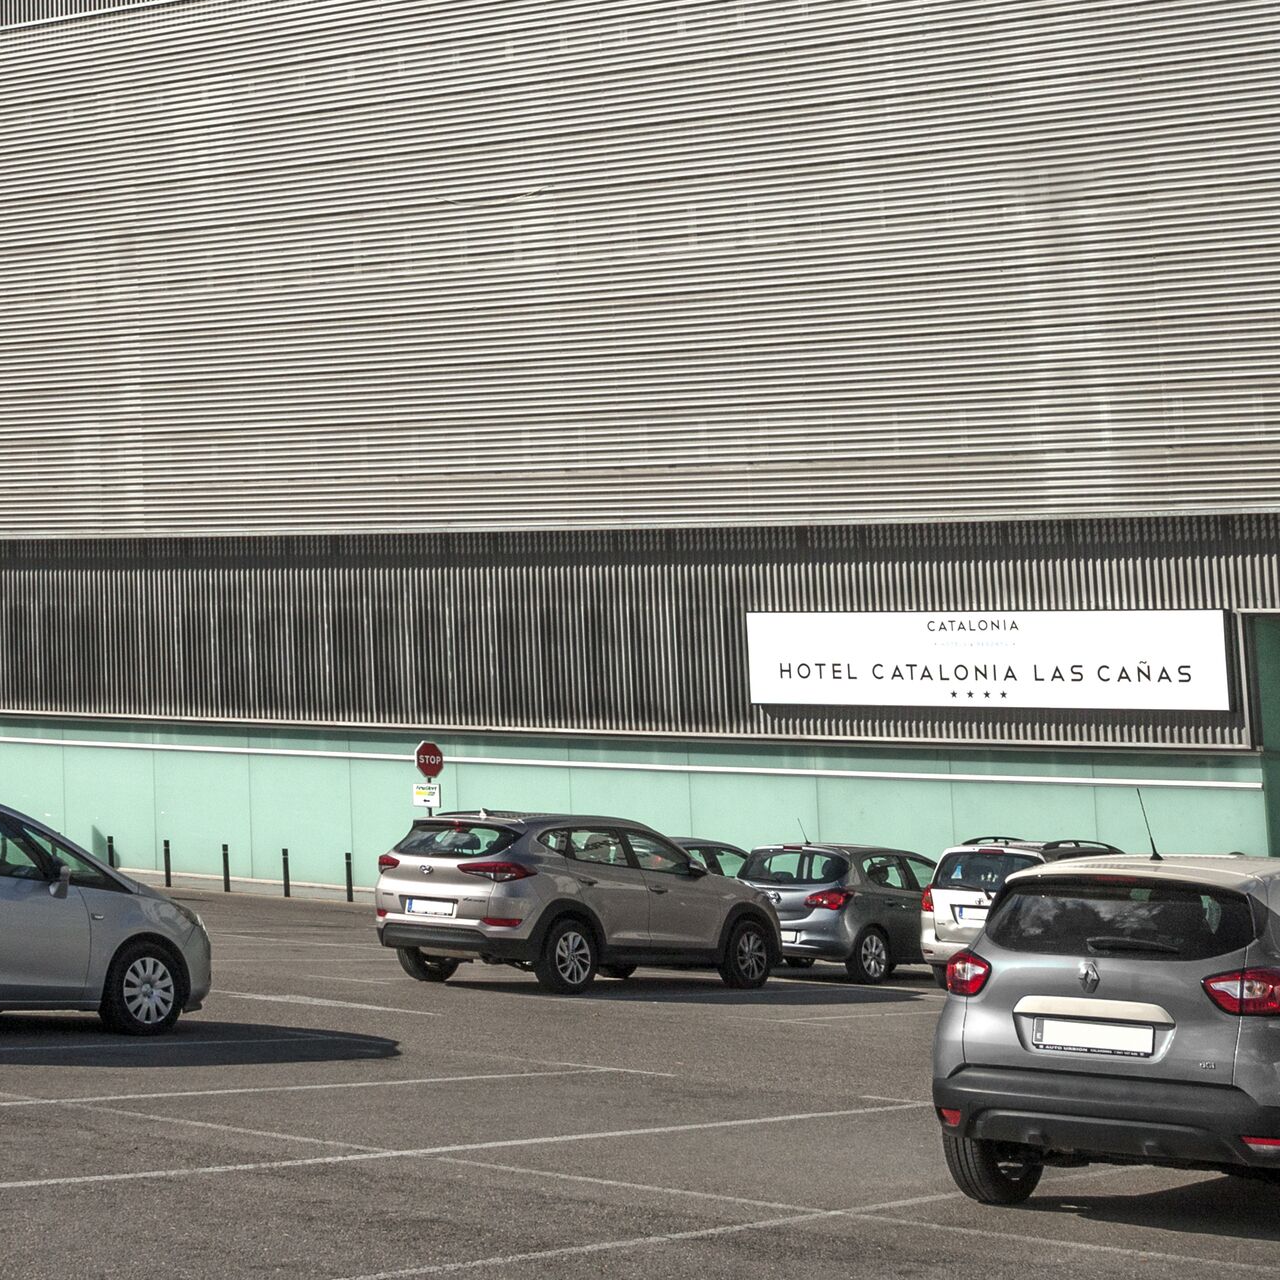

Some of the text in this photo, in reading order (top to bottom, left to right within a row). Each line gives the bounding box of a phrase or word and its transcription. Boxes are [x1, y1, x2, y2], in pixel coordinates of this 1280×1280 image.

[926, 619, 1020, 632] CATALONIA
[779, 660, 1192, 683] HOTEL CATALONIA LAS CAÑAS
[419, 754, 441, 765] STOP
